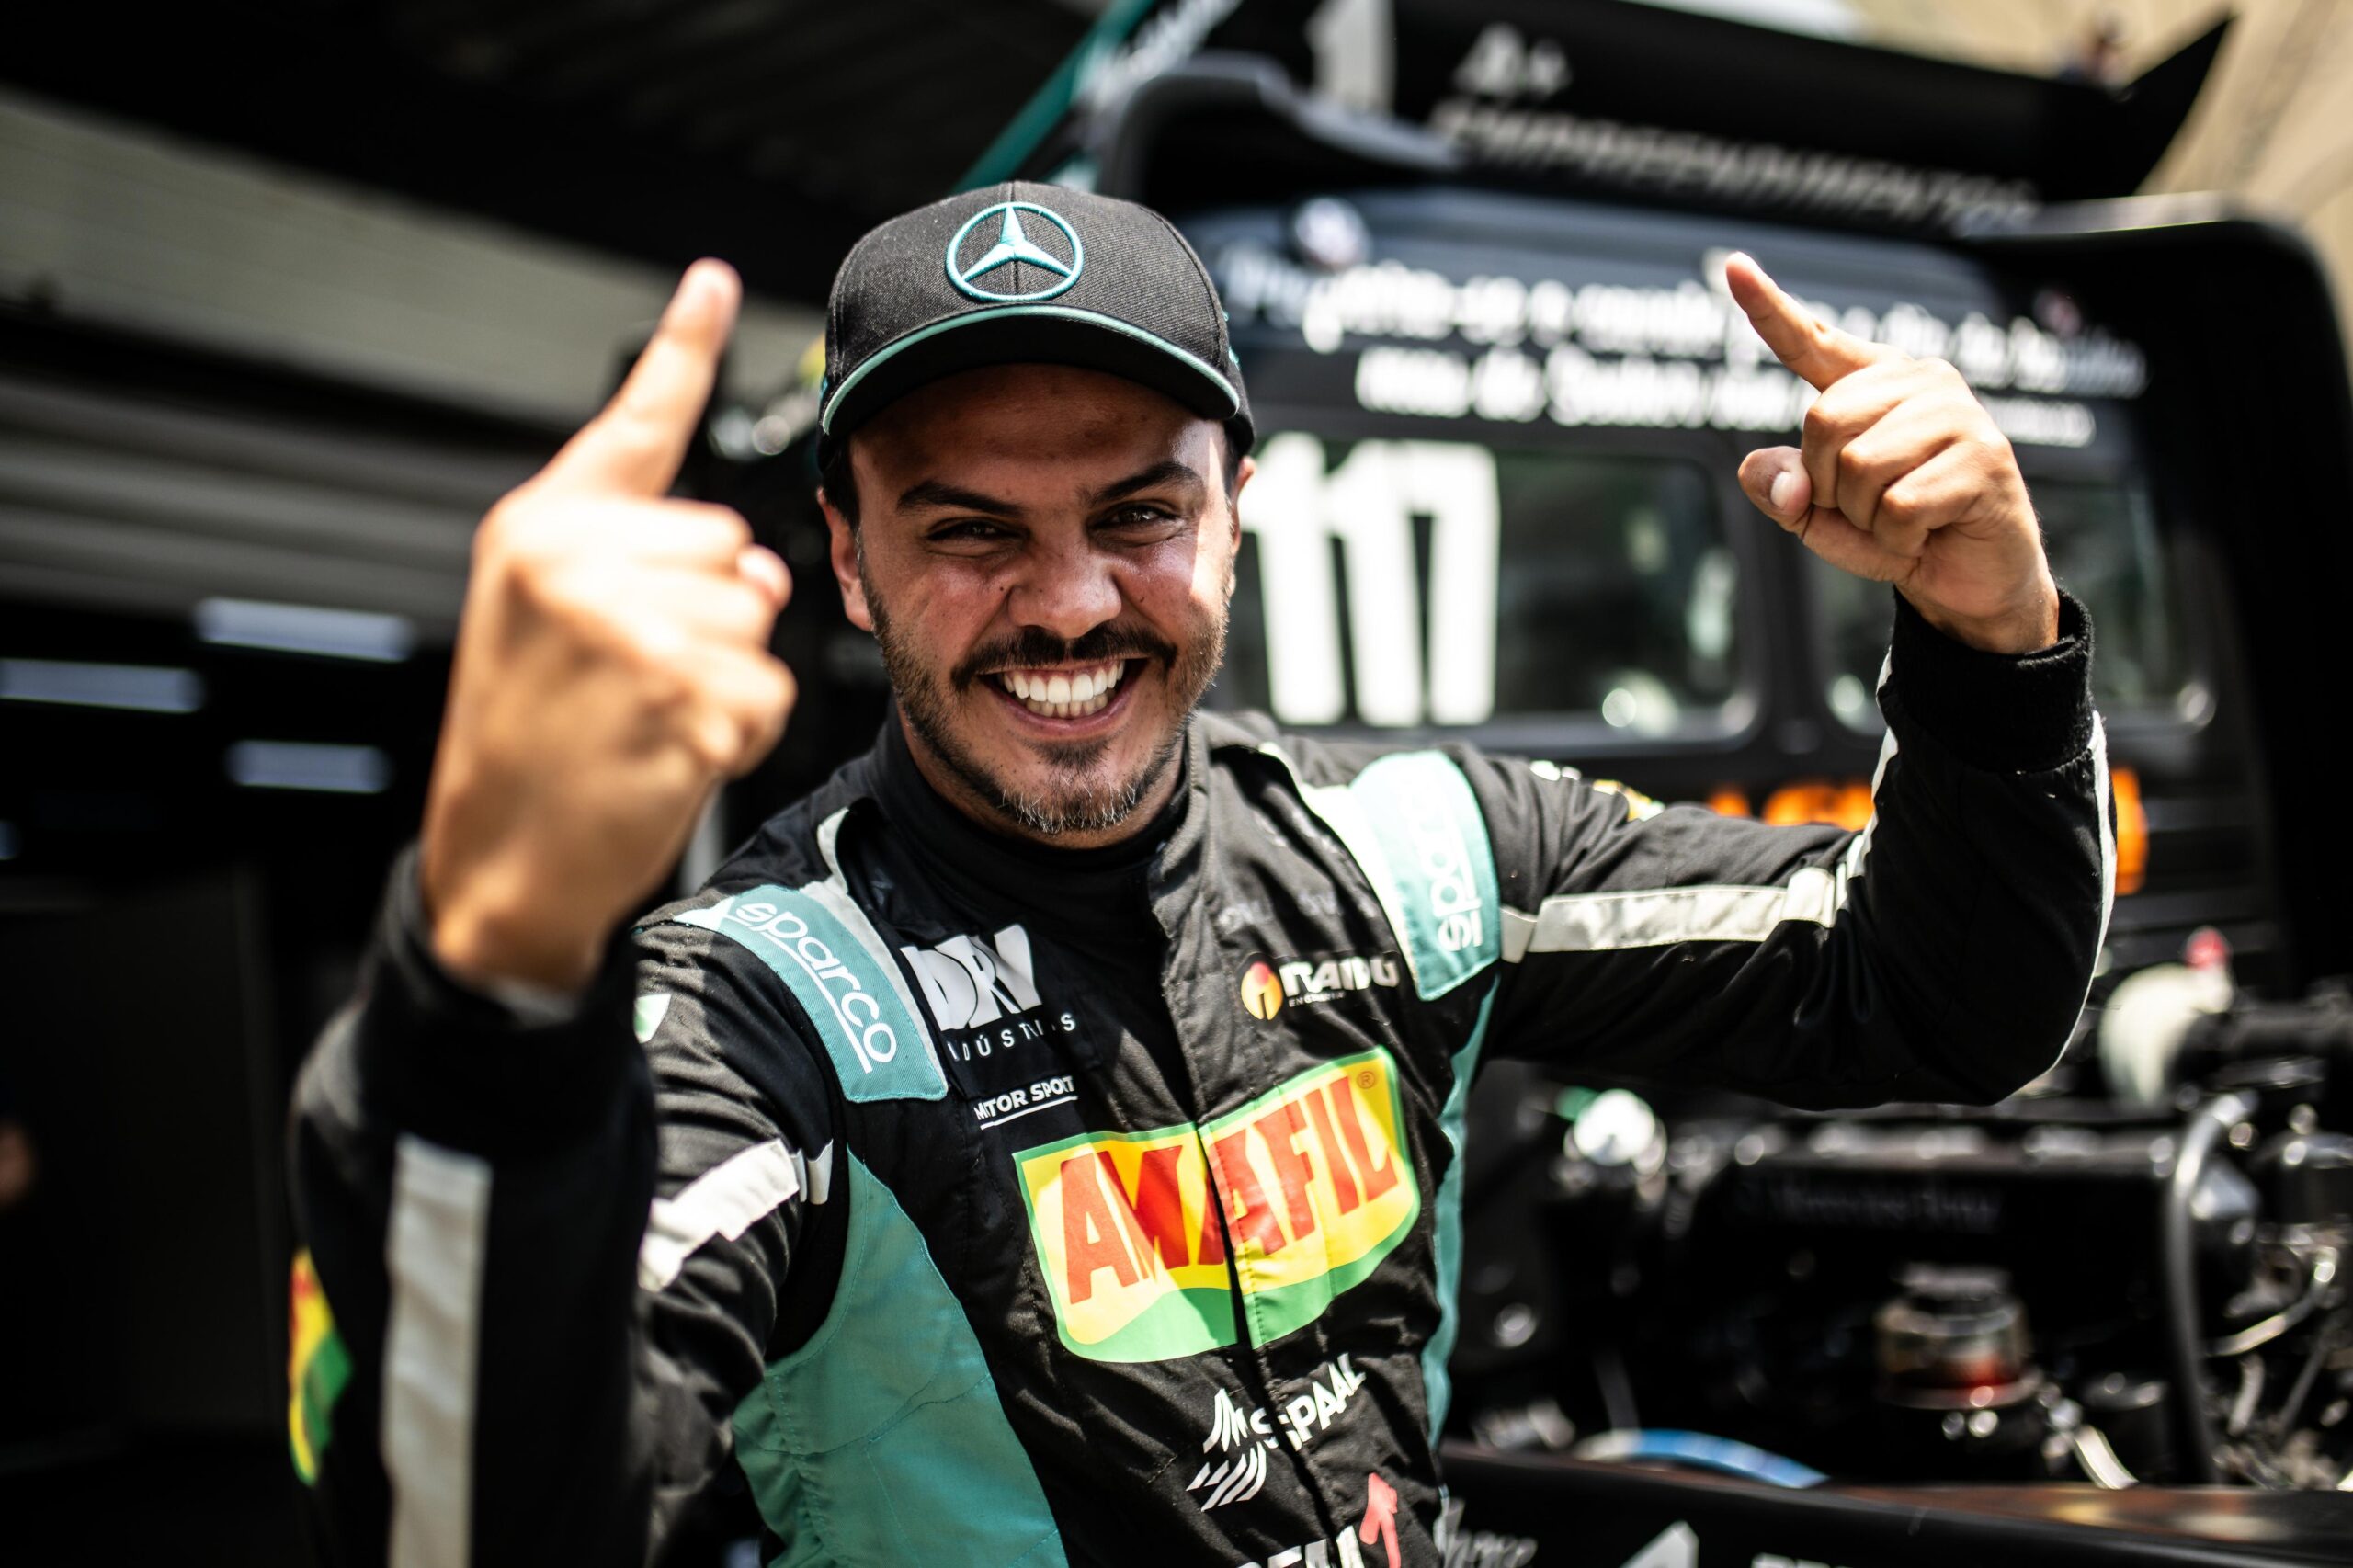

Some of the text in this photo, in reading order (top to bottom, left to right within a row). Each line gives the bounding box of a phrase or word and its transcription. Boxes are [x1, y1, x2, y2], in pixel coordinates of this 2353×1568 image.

[736, 903, 897, 1063] sparco
[973, 1090, 1029, 1121] MTOR
[1060, 1077, 1398, 1304] AMAFIL
